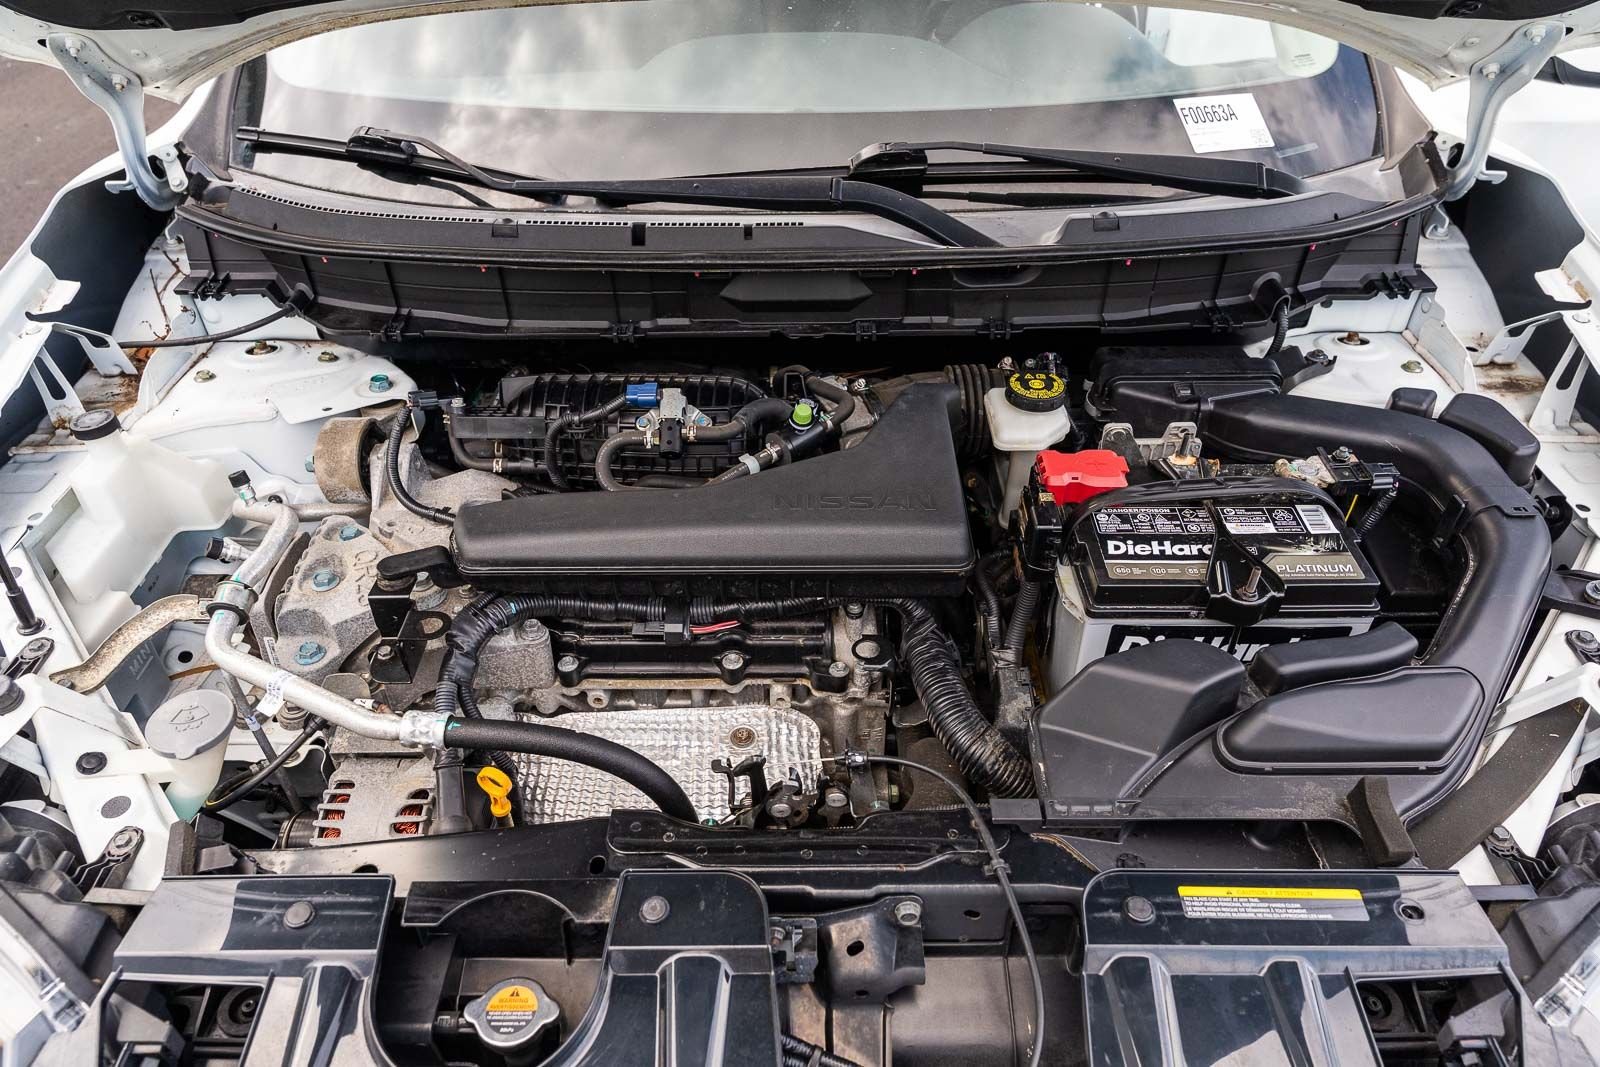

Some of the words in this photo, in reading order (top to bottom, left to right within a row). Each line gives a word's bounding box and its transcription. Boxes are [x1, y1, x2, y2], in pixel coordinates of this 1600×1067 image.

[1180, 103, 1239, 125] F00663A
[771, 493, 938, 512] NISSAN
[1275, 564, 1354, 573] PLATINUM
